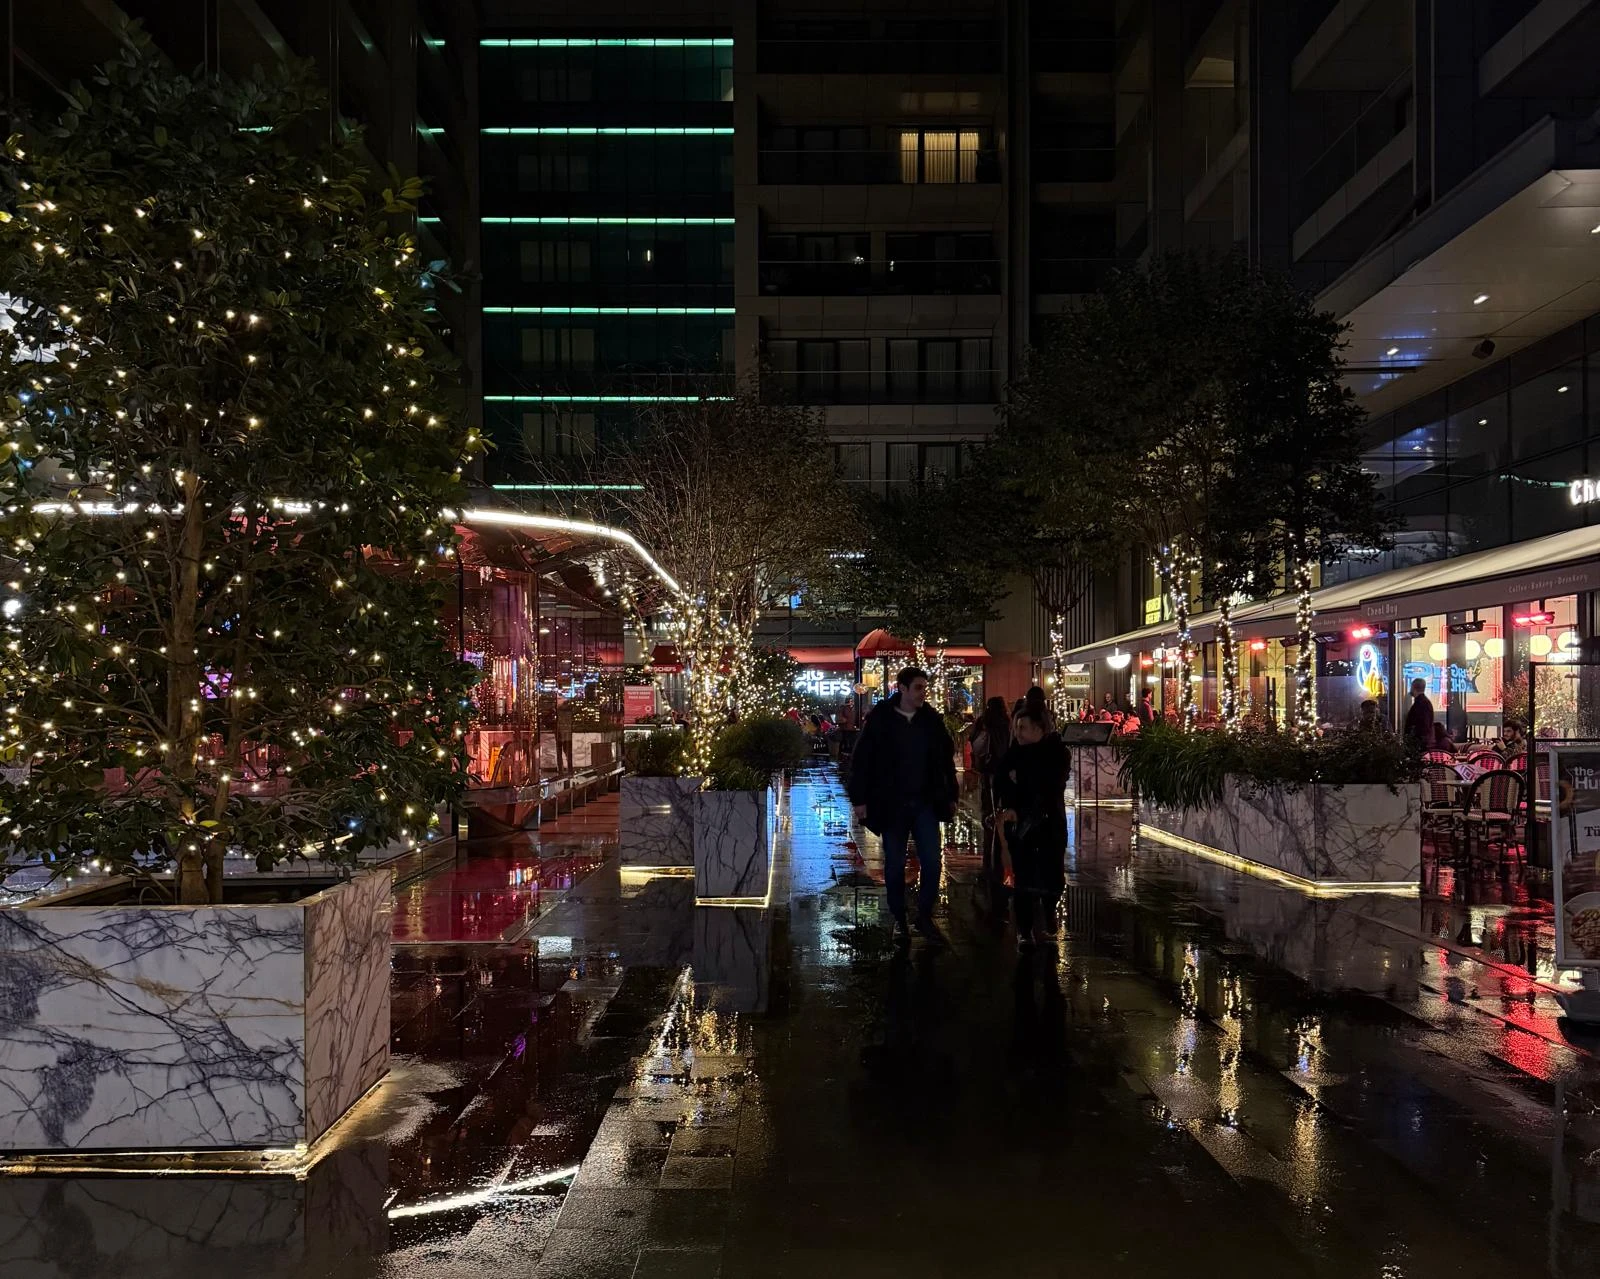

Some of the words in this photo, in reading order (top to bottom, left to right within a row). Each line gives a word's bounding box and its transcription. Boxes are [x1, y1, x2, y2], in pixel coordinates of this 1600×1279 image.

[795, 681, 852, 696] CHEFS
[1574, 766, 1594, 776] the
[1574, 776, 1600, 790] Hu
